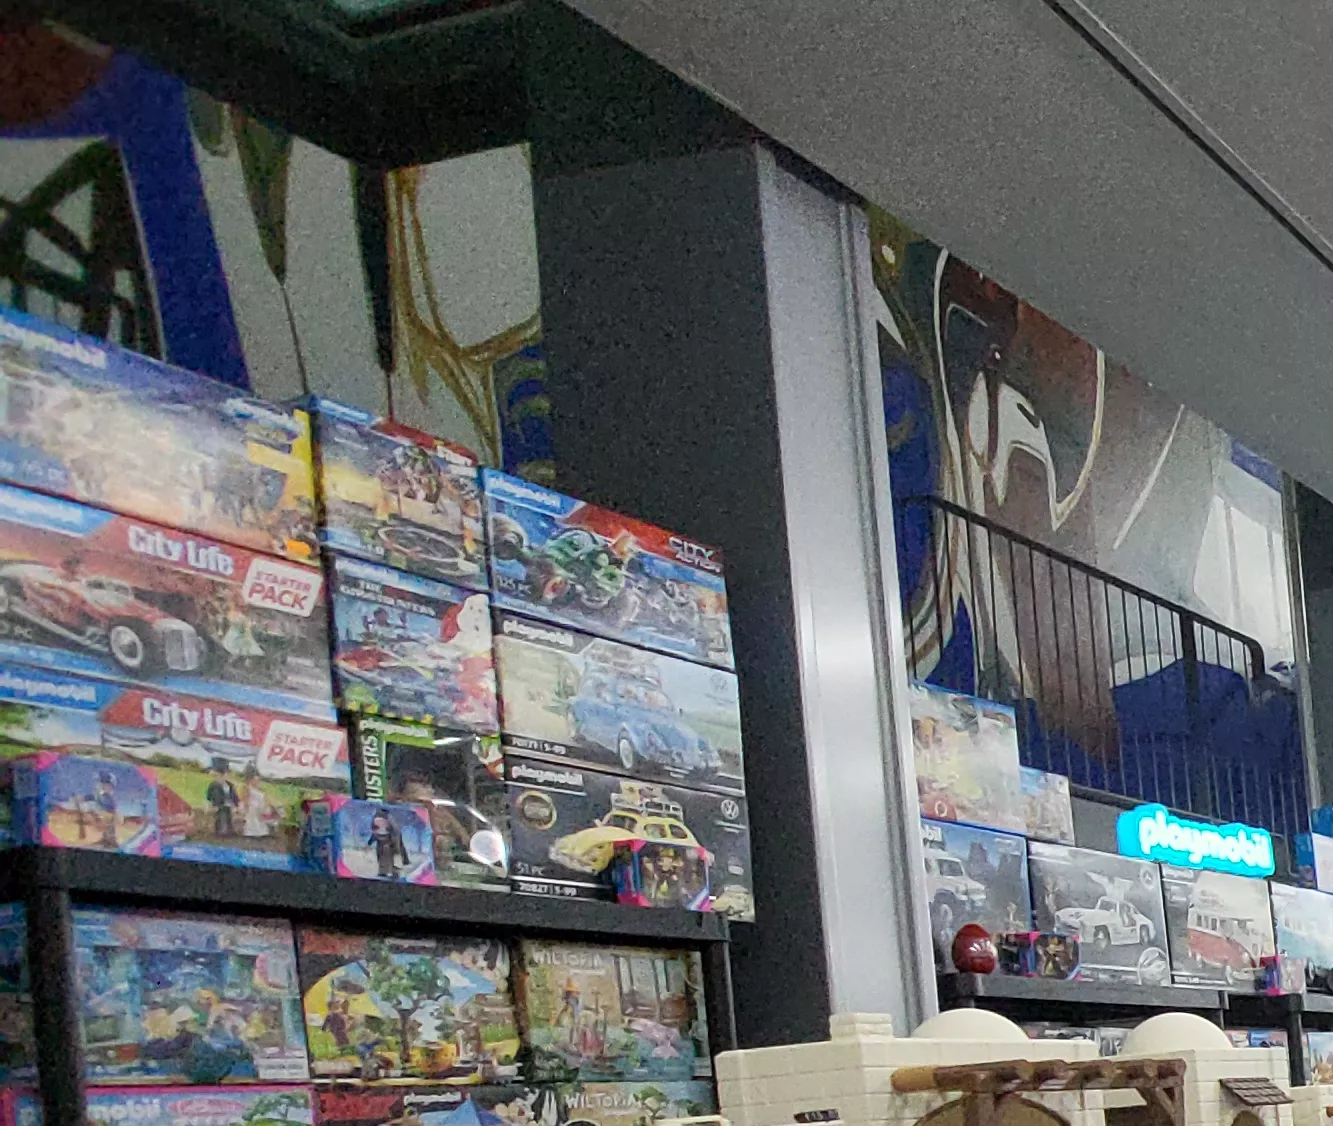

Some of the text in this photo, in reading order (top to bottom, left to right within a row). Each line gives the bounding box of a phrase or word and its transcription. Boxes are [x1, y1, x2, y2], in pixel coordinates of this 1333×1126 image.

[128, 524, 234, 577] City Life
[248, 583, 307, 610] PACK
[142, 698, 251, 739] City Life
[266, 745, 328, 768] PACK
[511, 763, 584, 786] playmobil
[1138, 810, 1272, 869] playmobil
